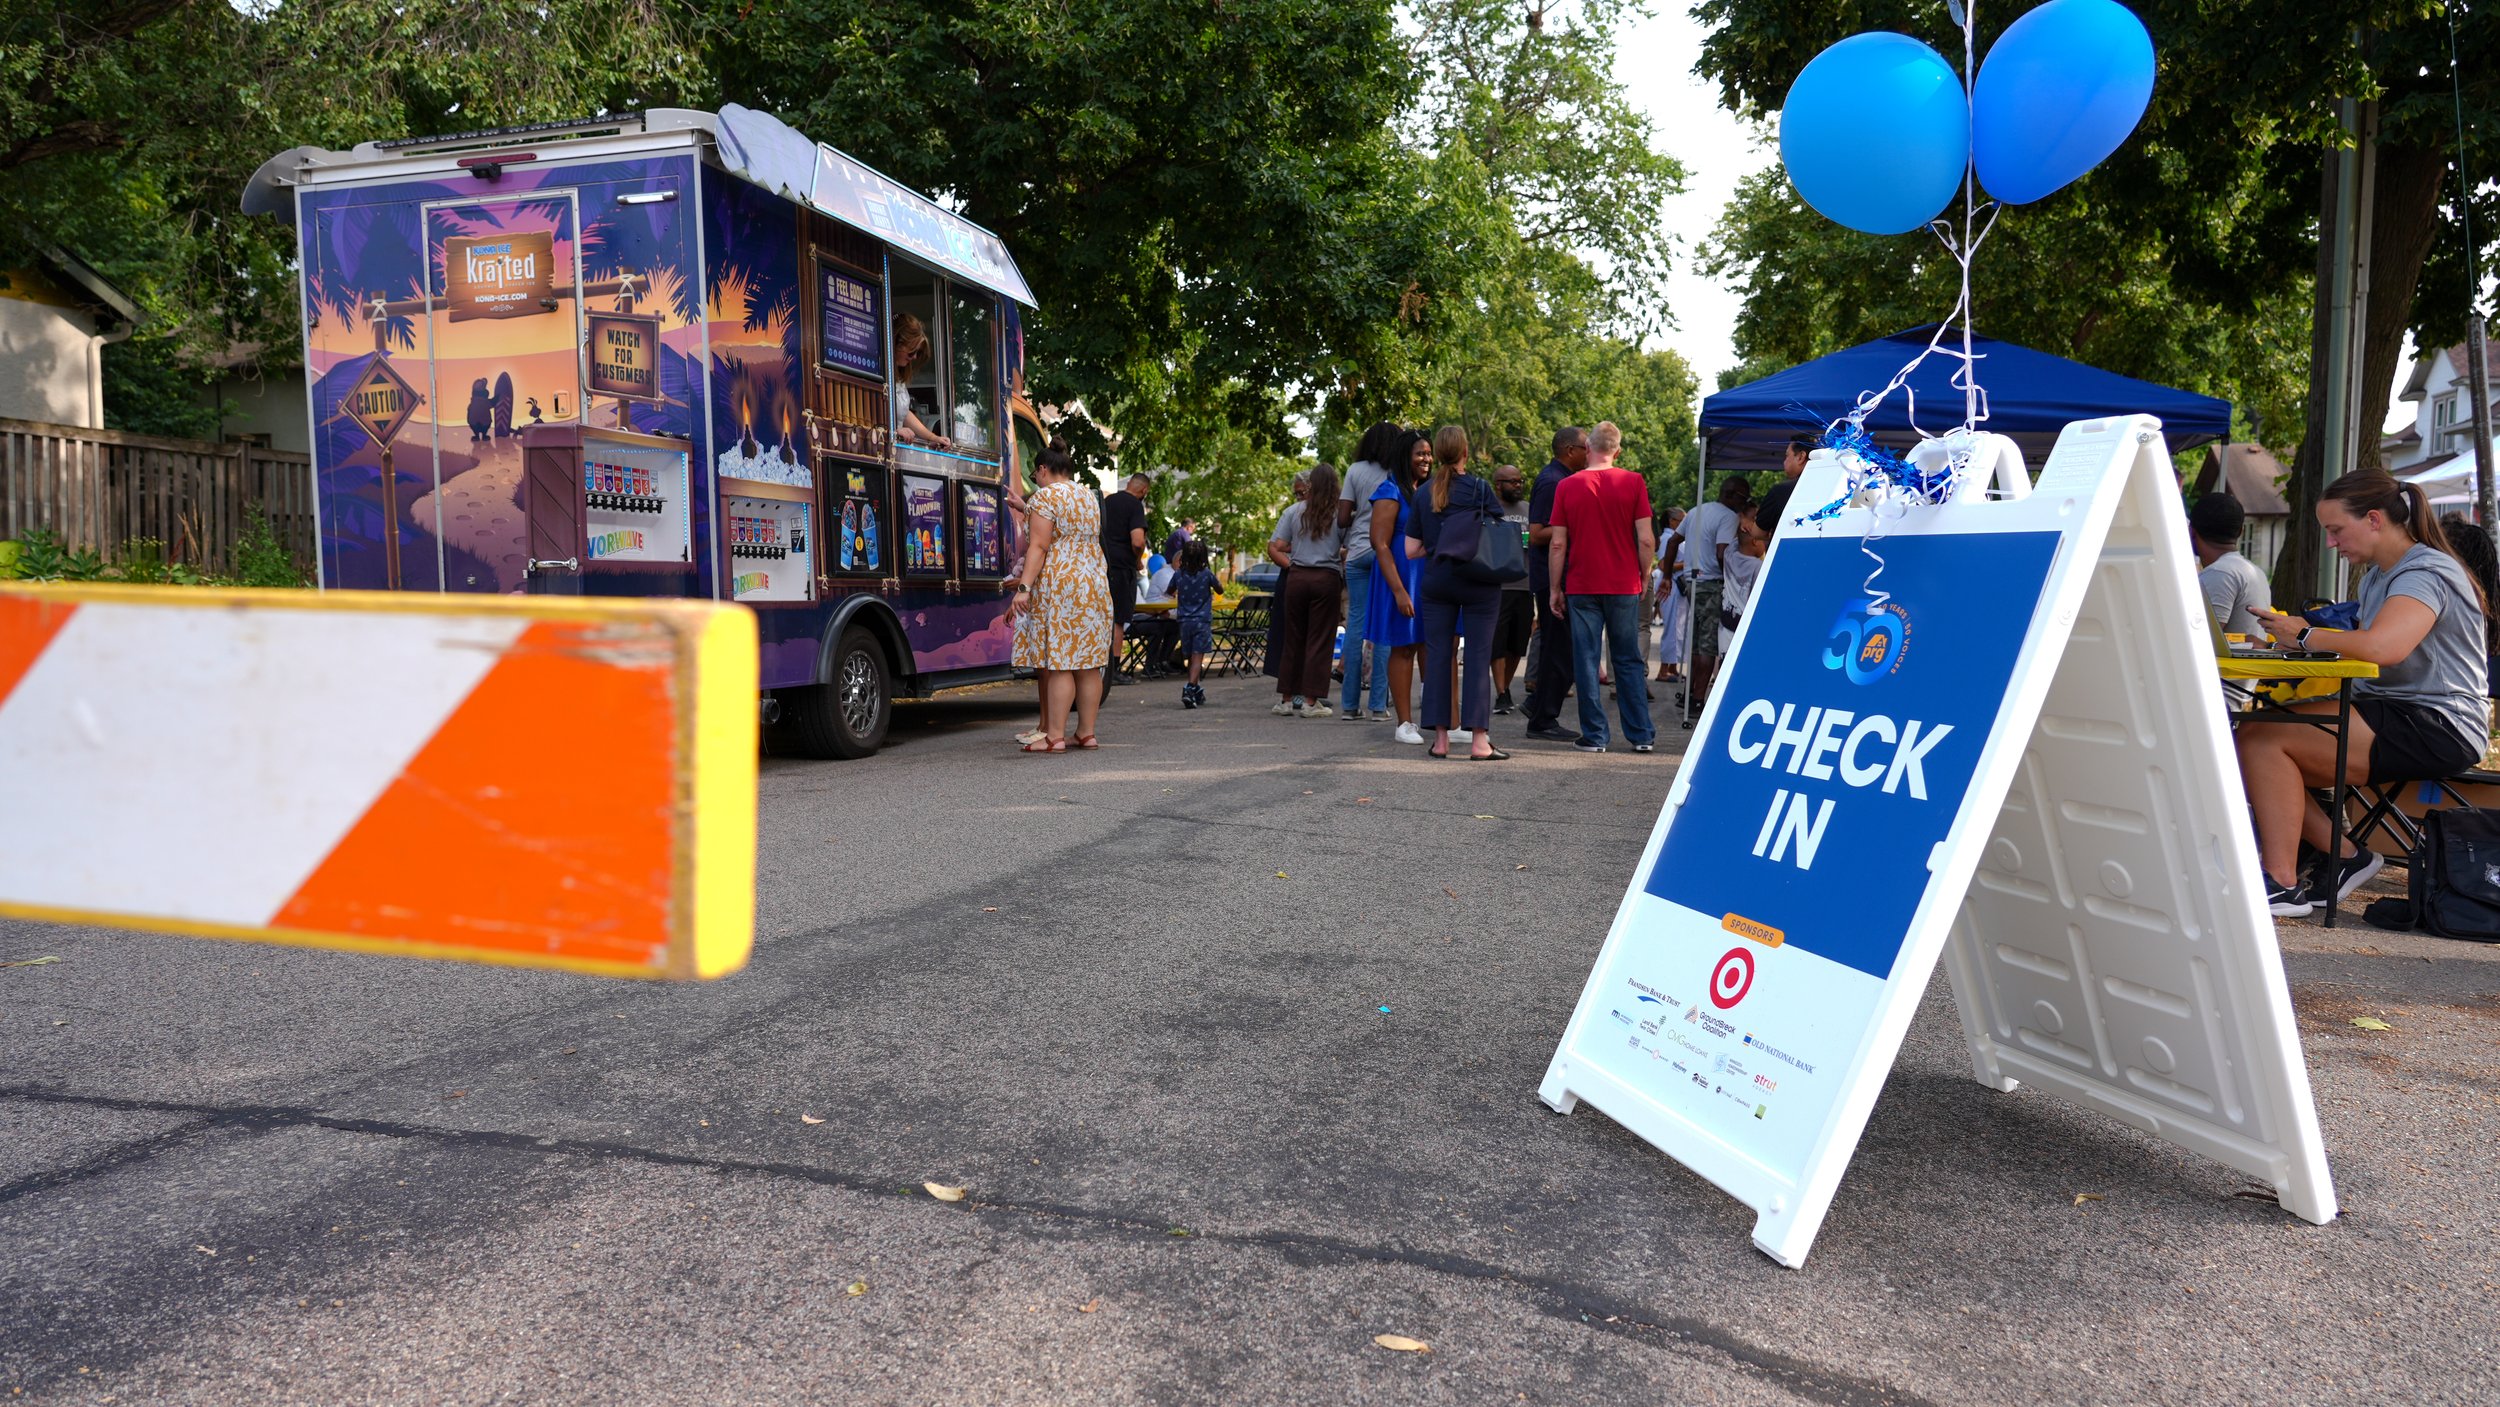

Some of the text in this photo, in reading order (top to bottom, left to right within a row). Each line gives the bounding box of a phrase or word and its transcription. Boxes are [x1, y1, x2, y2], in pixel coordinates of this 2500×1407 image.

[836, 277, 849, 297] FEEL
[475, 293, 527, 303] KONA-ICE.COM
[607, 329, 640, 349] WATCH
[615, 348, 633, 365] FOR
[596, 362, 651, 385] CUSTOMERS
[357, 389, 405, 415] CAUTION
[1890, 603, 1907, 619] YEARS
[1904, 623, 1912, 635] 50
[1860, 647, 1885, 663] prg
[1890, 638, 1911, 675] VOICES
[1728, 699, 1955, 800] CHECK
[1752, 789, 1836, 870] IN
[1730, 918, 1775, 942] SPONSORS
[1699, 1011, 1736, 1034] GroundBreak
[1702, 1022, 1727, 1039] Coalition
[1751, 1039, 1814, 1074] OLD NATIONAL BANK
[1754, 1074, 1777, 1092] strut
